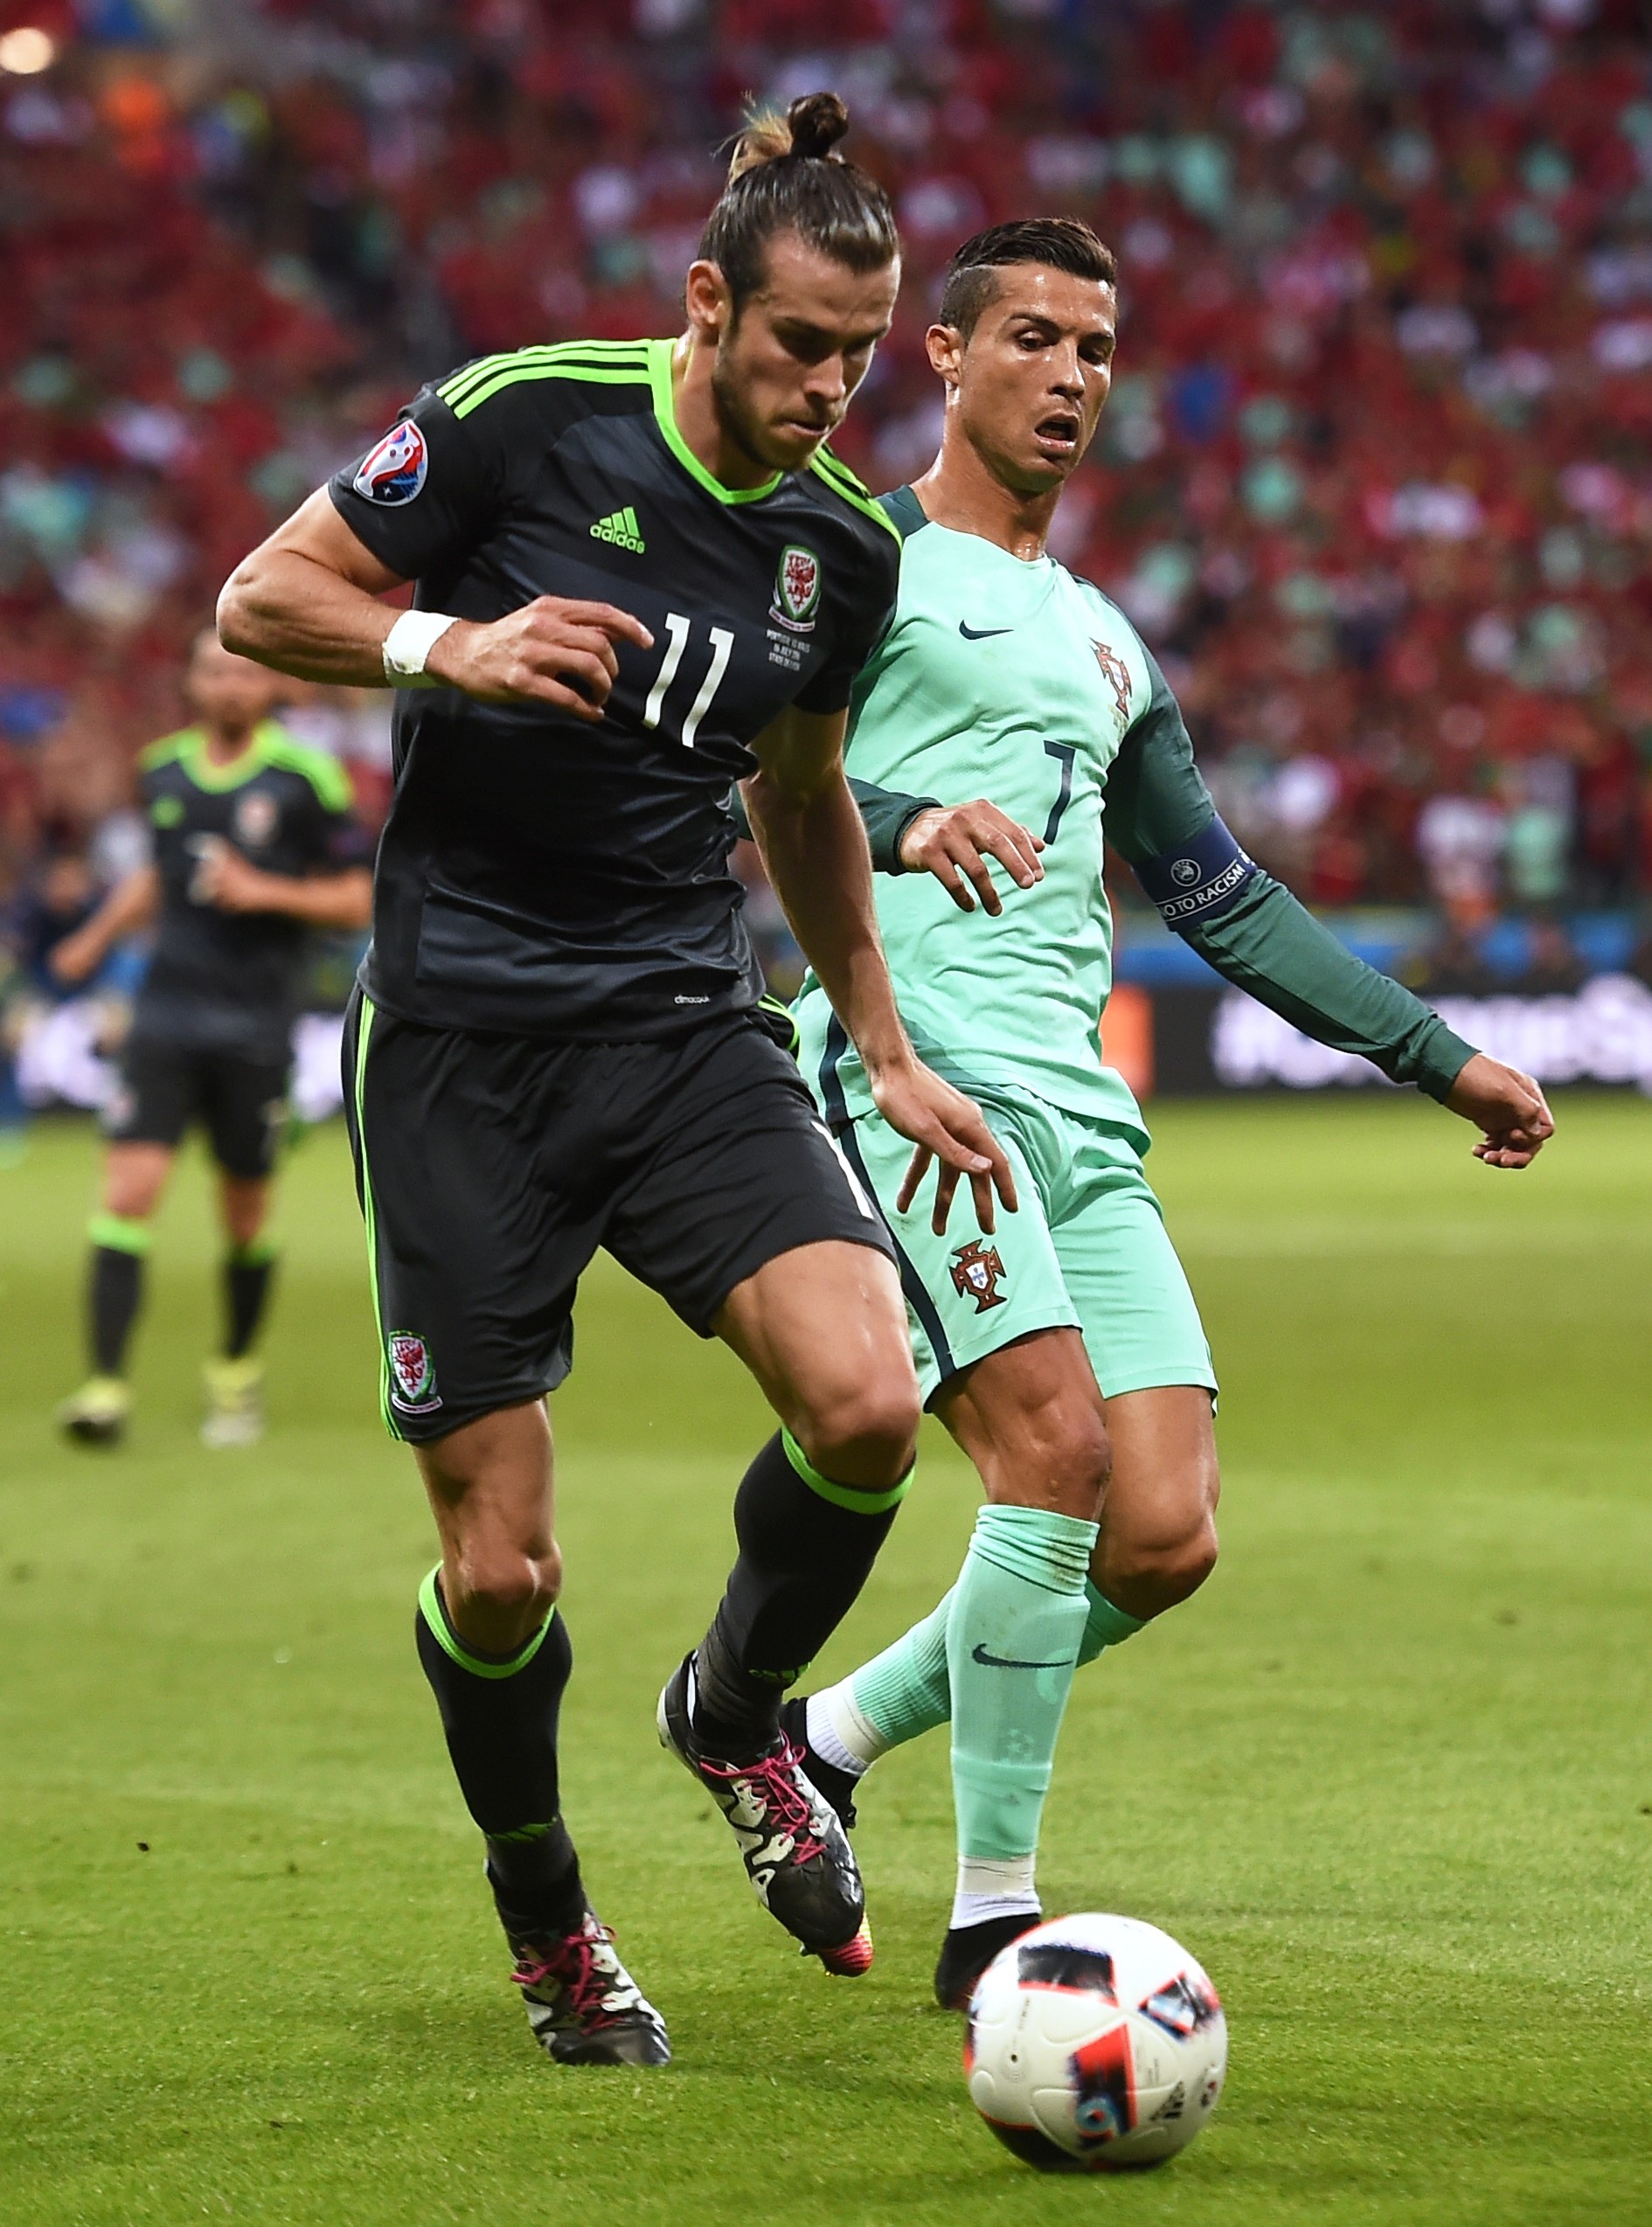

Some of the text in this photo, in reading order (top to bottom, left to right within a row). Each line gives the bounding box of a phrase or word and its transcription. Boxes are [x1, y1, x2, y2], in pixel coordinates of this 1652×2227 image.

[589, 524, 645, 555] adidas
[642, 613, 734, 748] 11
[1043, 739, 1076, 845] 7
[1176, 898, 1196, 914] TO
[1196, 864, 1246, 905] RACISM
